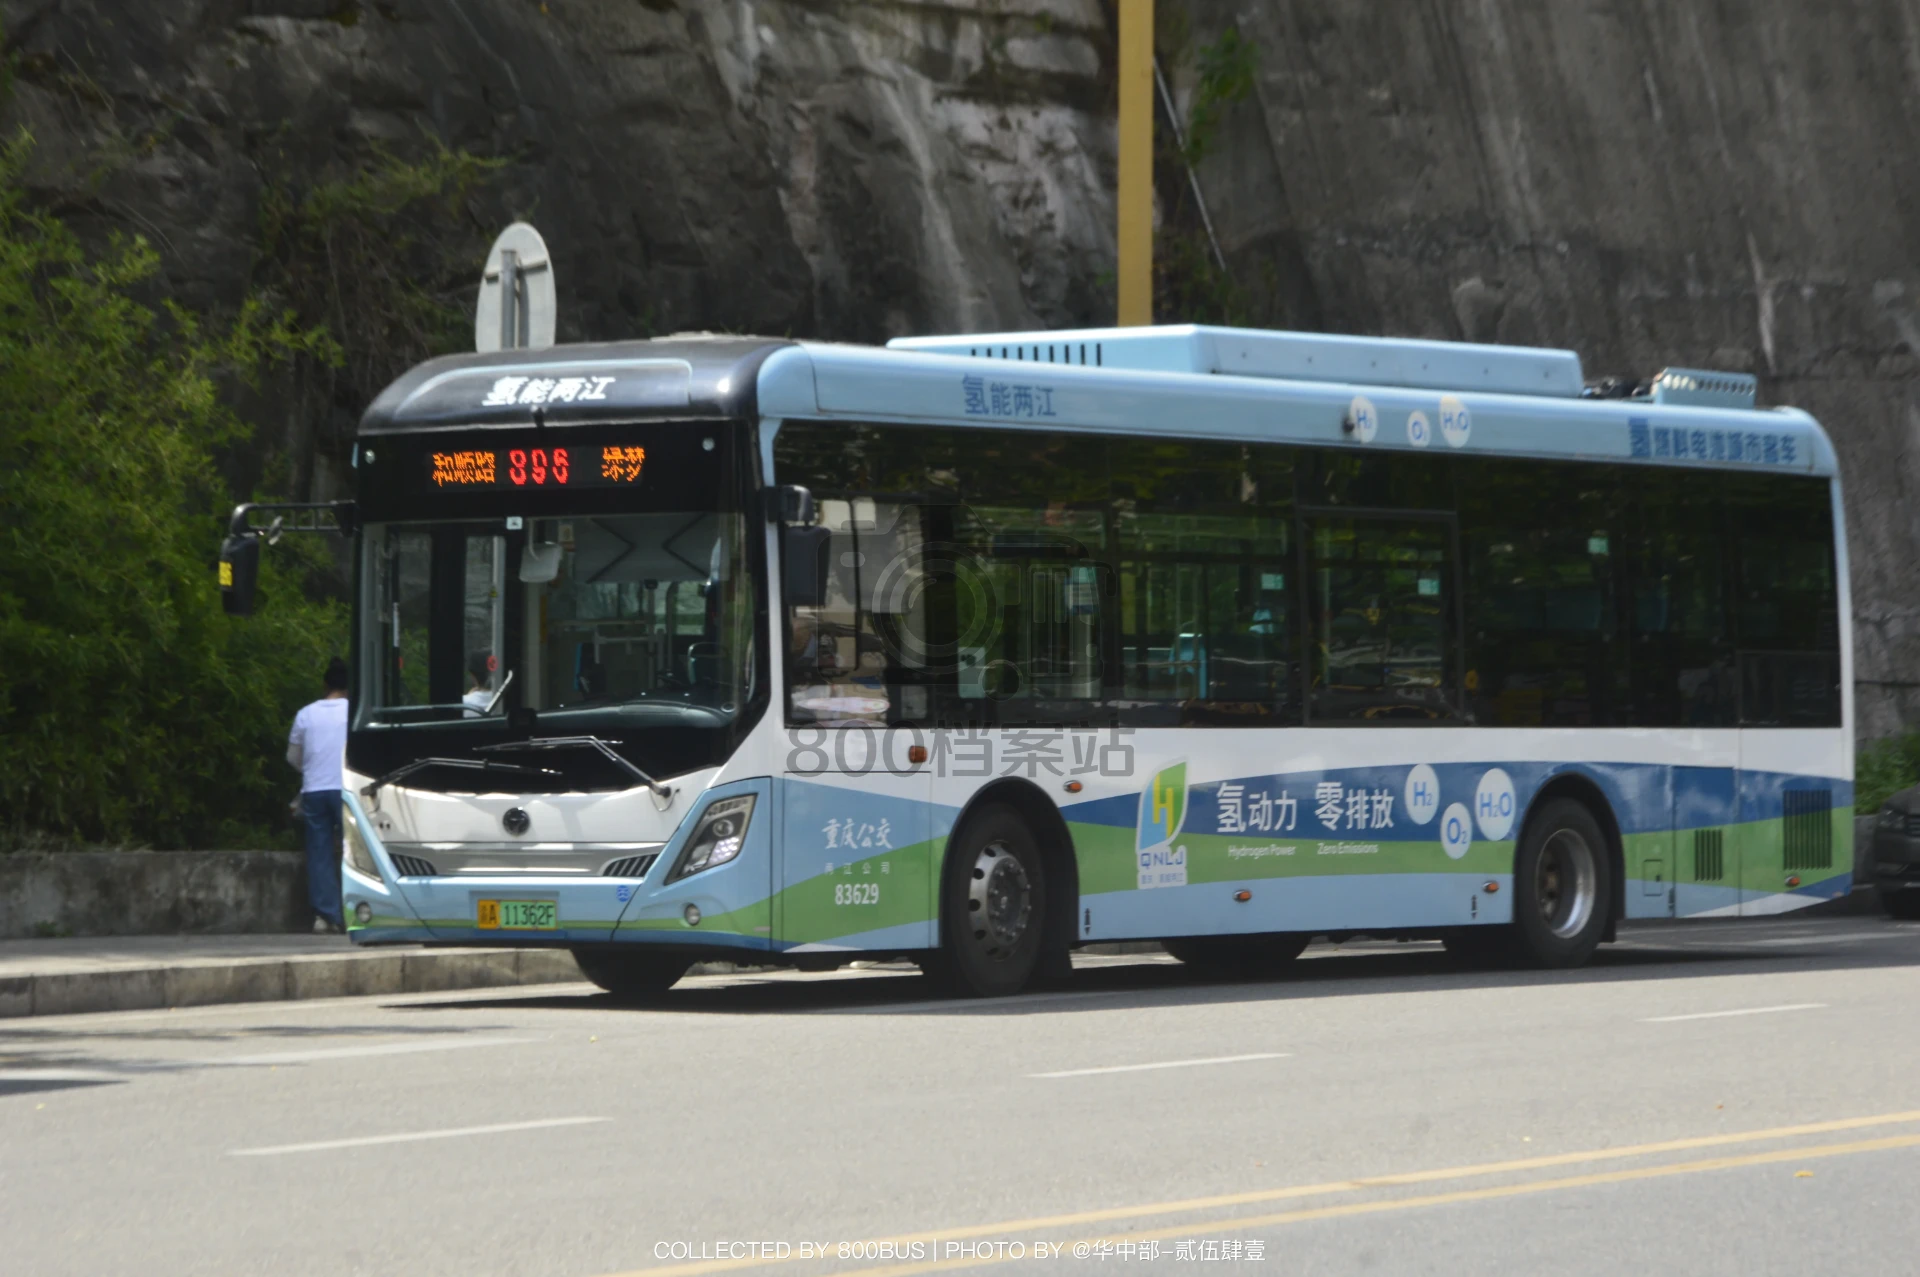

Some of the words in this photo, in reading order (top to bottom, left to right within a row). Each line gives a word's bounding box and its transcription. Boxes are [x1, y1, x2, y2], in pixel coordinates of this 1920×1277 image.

[482, 376, 616, 406] 氢能两江
[962, 373, 1057, 417] 氢能两江
[1413, 782, 1433, 806] H2
[1480, 791, 1513, 818] H2O
[1216, 782, 1298, 833] 氢动力
[1314, 781, 1395, 831] 零排放
[821, 818, 893, 849] 重庆公交
[1446, 817, 1468, 845] O2
[1141, 851, 1185, 869] QNLJ
[1228, 844, 1269, 860] Hydrogen
[1270, 844, 1297, 857] Power
[1316, 842, 1337, 855] Zero
[1338, 842, 1379, 855] Emissions
[835, 883, 879, 905] 83629
[504, 904, 555, 926] 11362F
